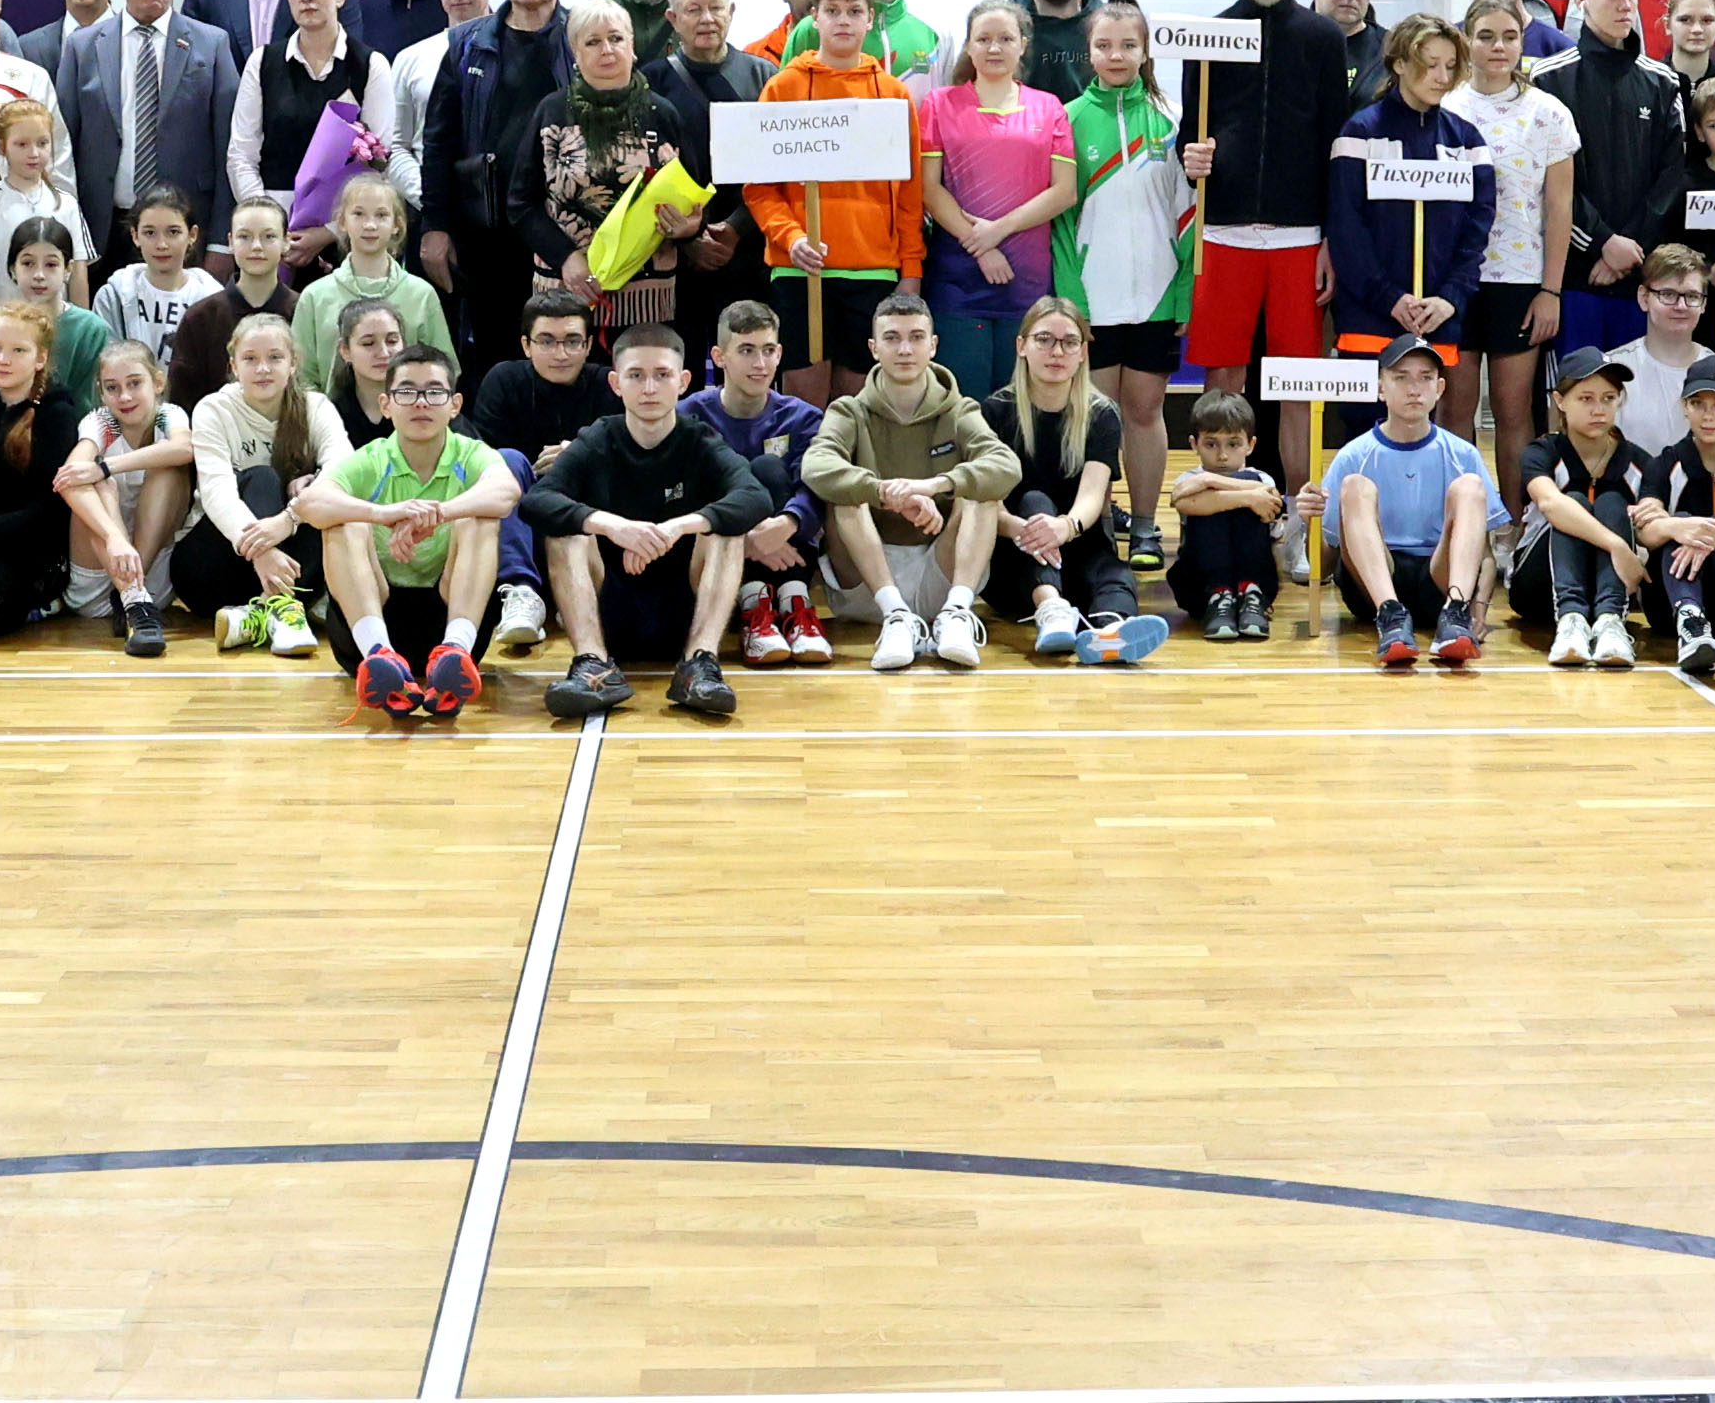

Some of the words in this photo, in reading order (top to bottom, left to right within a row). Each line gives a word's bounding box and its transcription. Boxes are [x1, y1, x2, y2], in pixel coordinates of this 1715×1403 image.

[1154, 25, 1260, 51] Обнинск
[759, 113, 850, 134] КАЛУЖСКАЯ
[772, 138, 841, 157] ОБЛАСТЬ
[1370, 162, 1472, 189] Тихорецк
[1267, 375, 1371, 398] Евпатория
